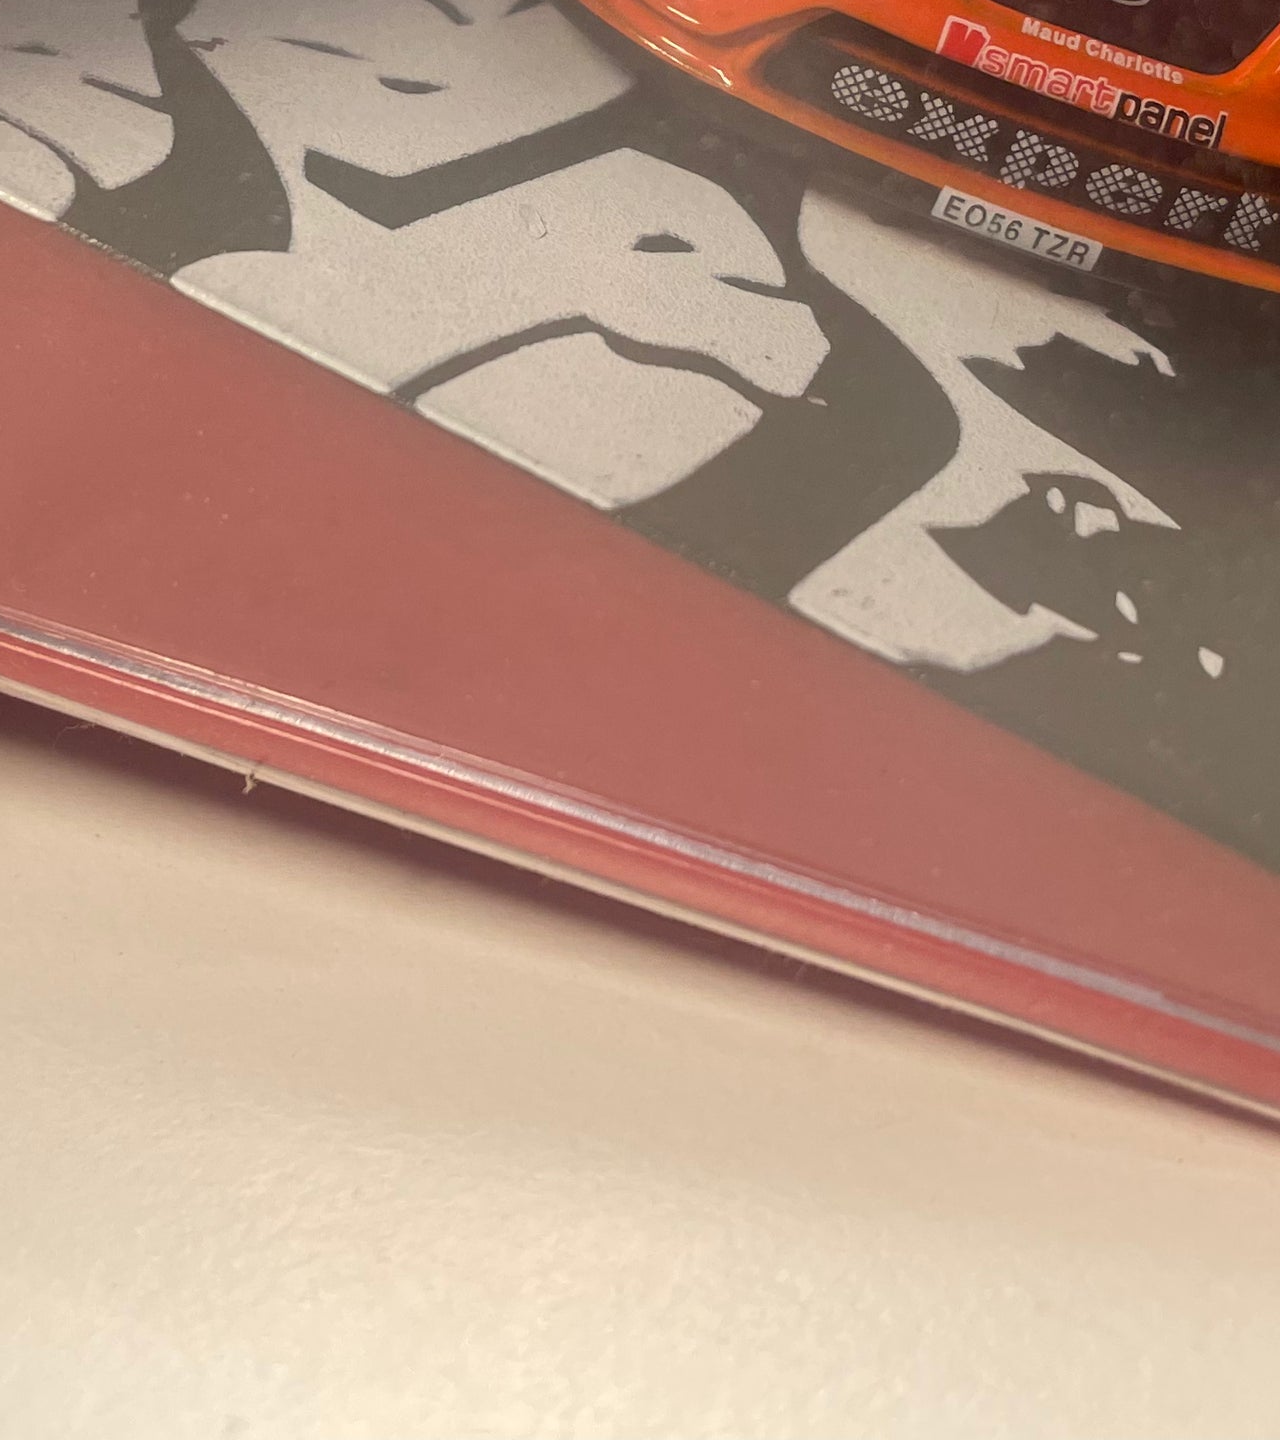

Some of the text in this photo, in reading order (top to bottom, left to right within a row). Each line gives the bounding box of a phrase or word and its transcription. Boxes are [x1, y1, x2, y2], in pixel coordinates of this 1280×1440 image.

[1021, 15, 1081, 53] Maud
[830, 64, 1280, 253] expert
[940, 193, 1092, 268] EO56 TZR
